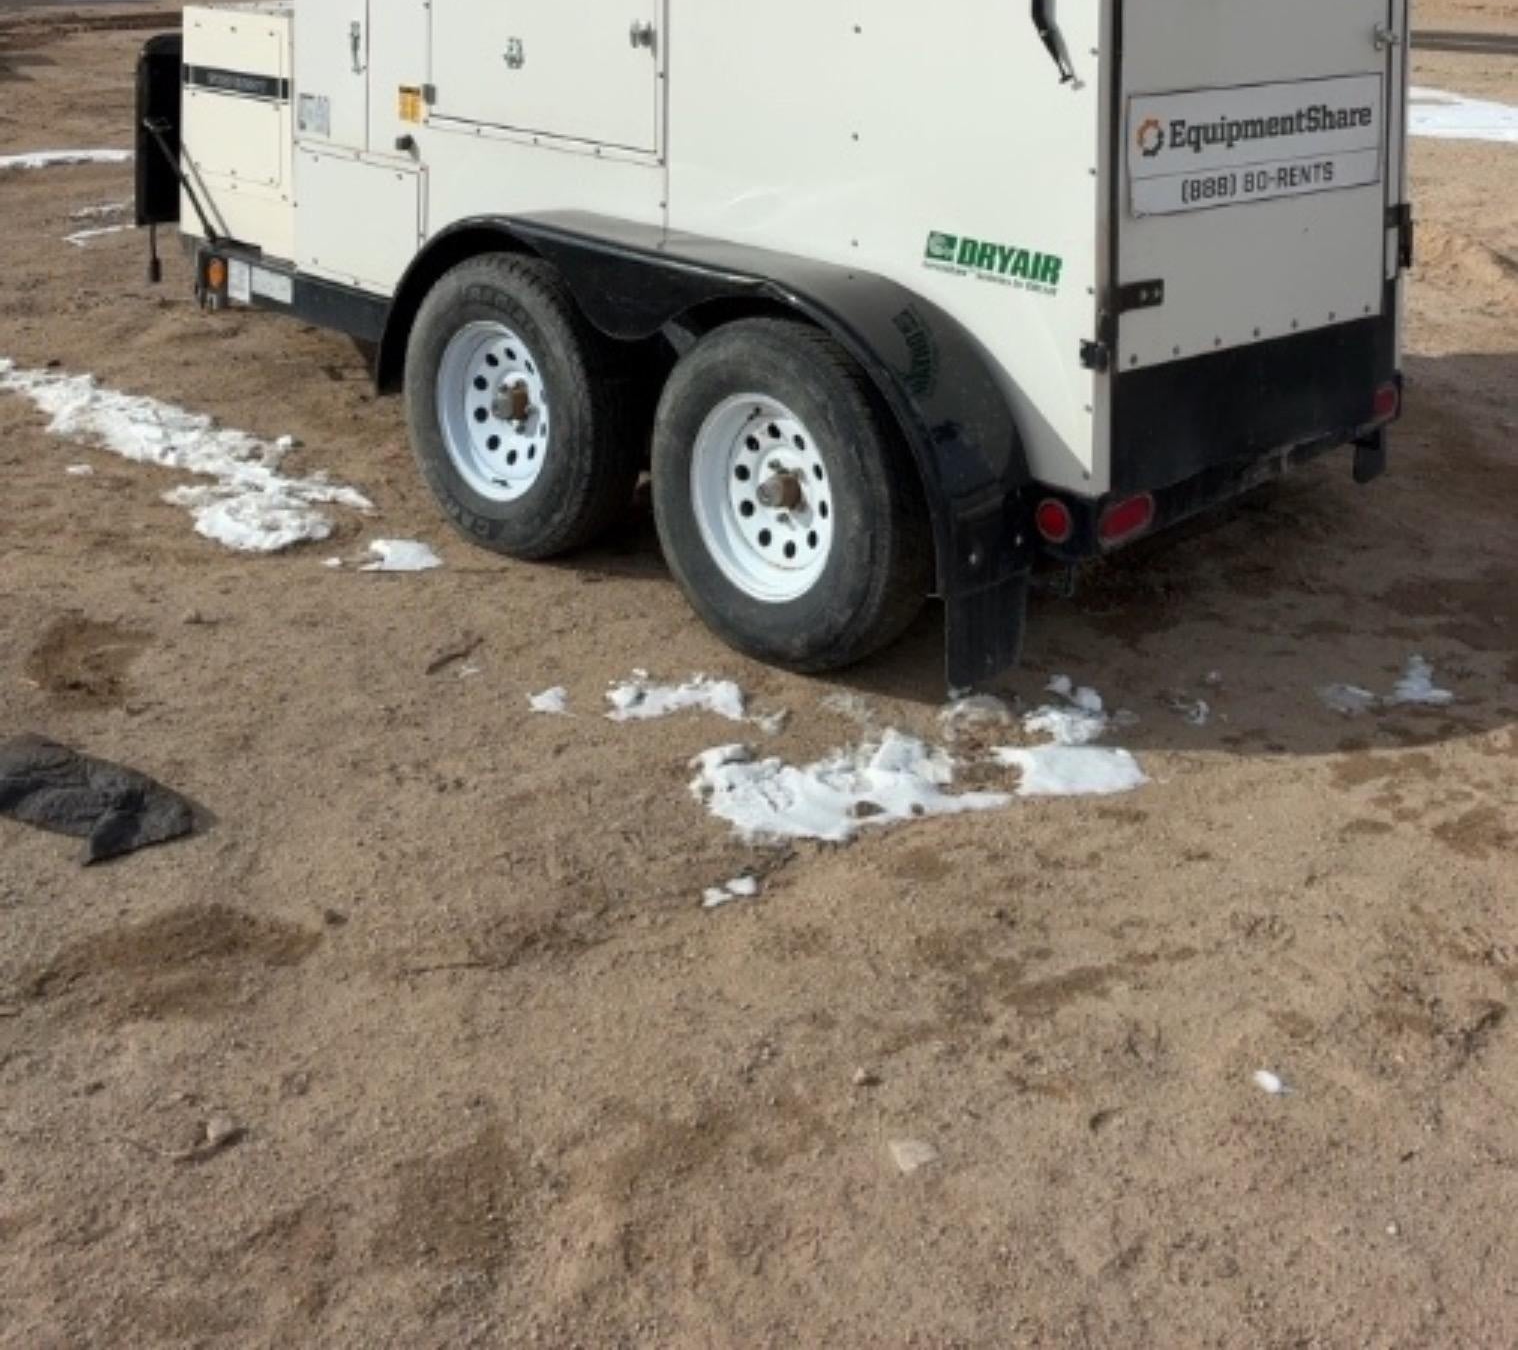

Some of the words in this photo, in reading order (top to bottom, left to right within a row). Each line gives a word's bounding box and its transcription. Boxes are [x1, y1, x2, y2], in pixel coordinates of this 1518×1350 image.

[1168, 103, 1372, 153] EquipmentShare
[1181, 173, 1236, 203] (888)
[1244, 161, 1333, 192] 80-RENTS
[957, 237, 1062, 285] DRYAIR
